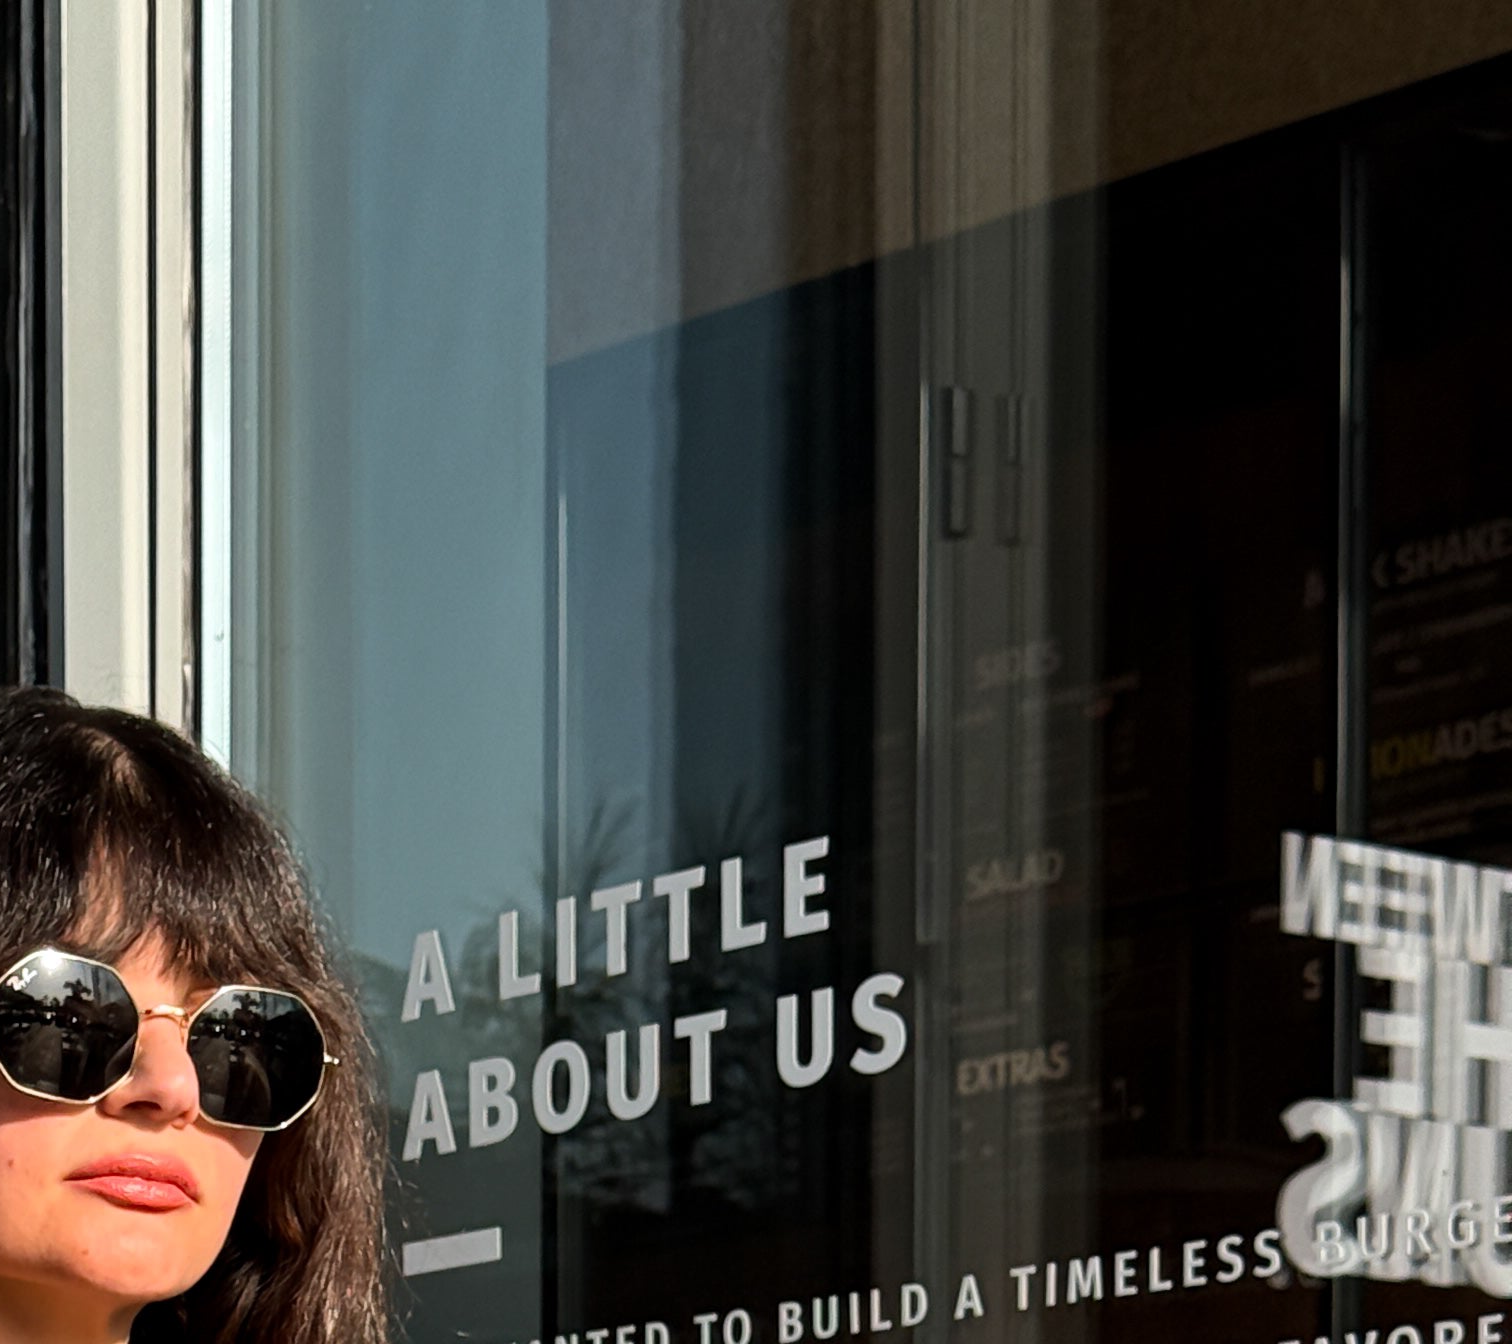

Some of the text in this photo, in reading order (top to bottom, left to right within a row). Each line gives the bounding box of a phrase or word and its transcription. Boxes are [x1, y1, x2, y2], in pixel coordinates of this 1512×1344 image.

[401, 835, 831, 1023] A LITTLE
[402, 972, 908, 1162] ABOUT US
[957, 1042, 1070, 1095] EXTRAS
[778, 1282, 930, 1344] BUILD
[953, 1274, 985, 1321] A
[1009, 1228, 1283, 1312] TIMELESS
